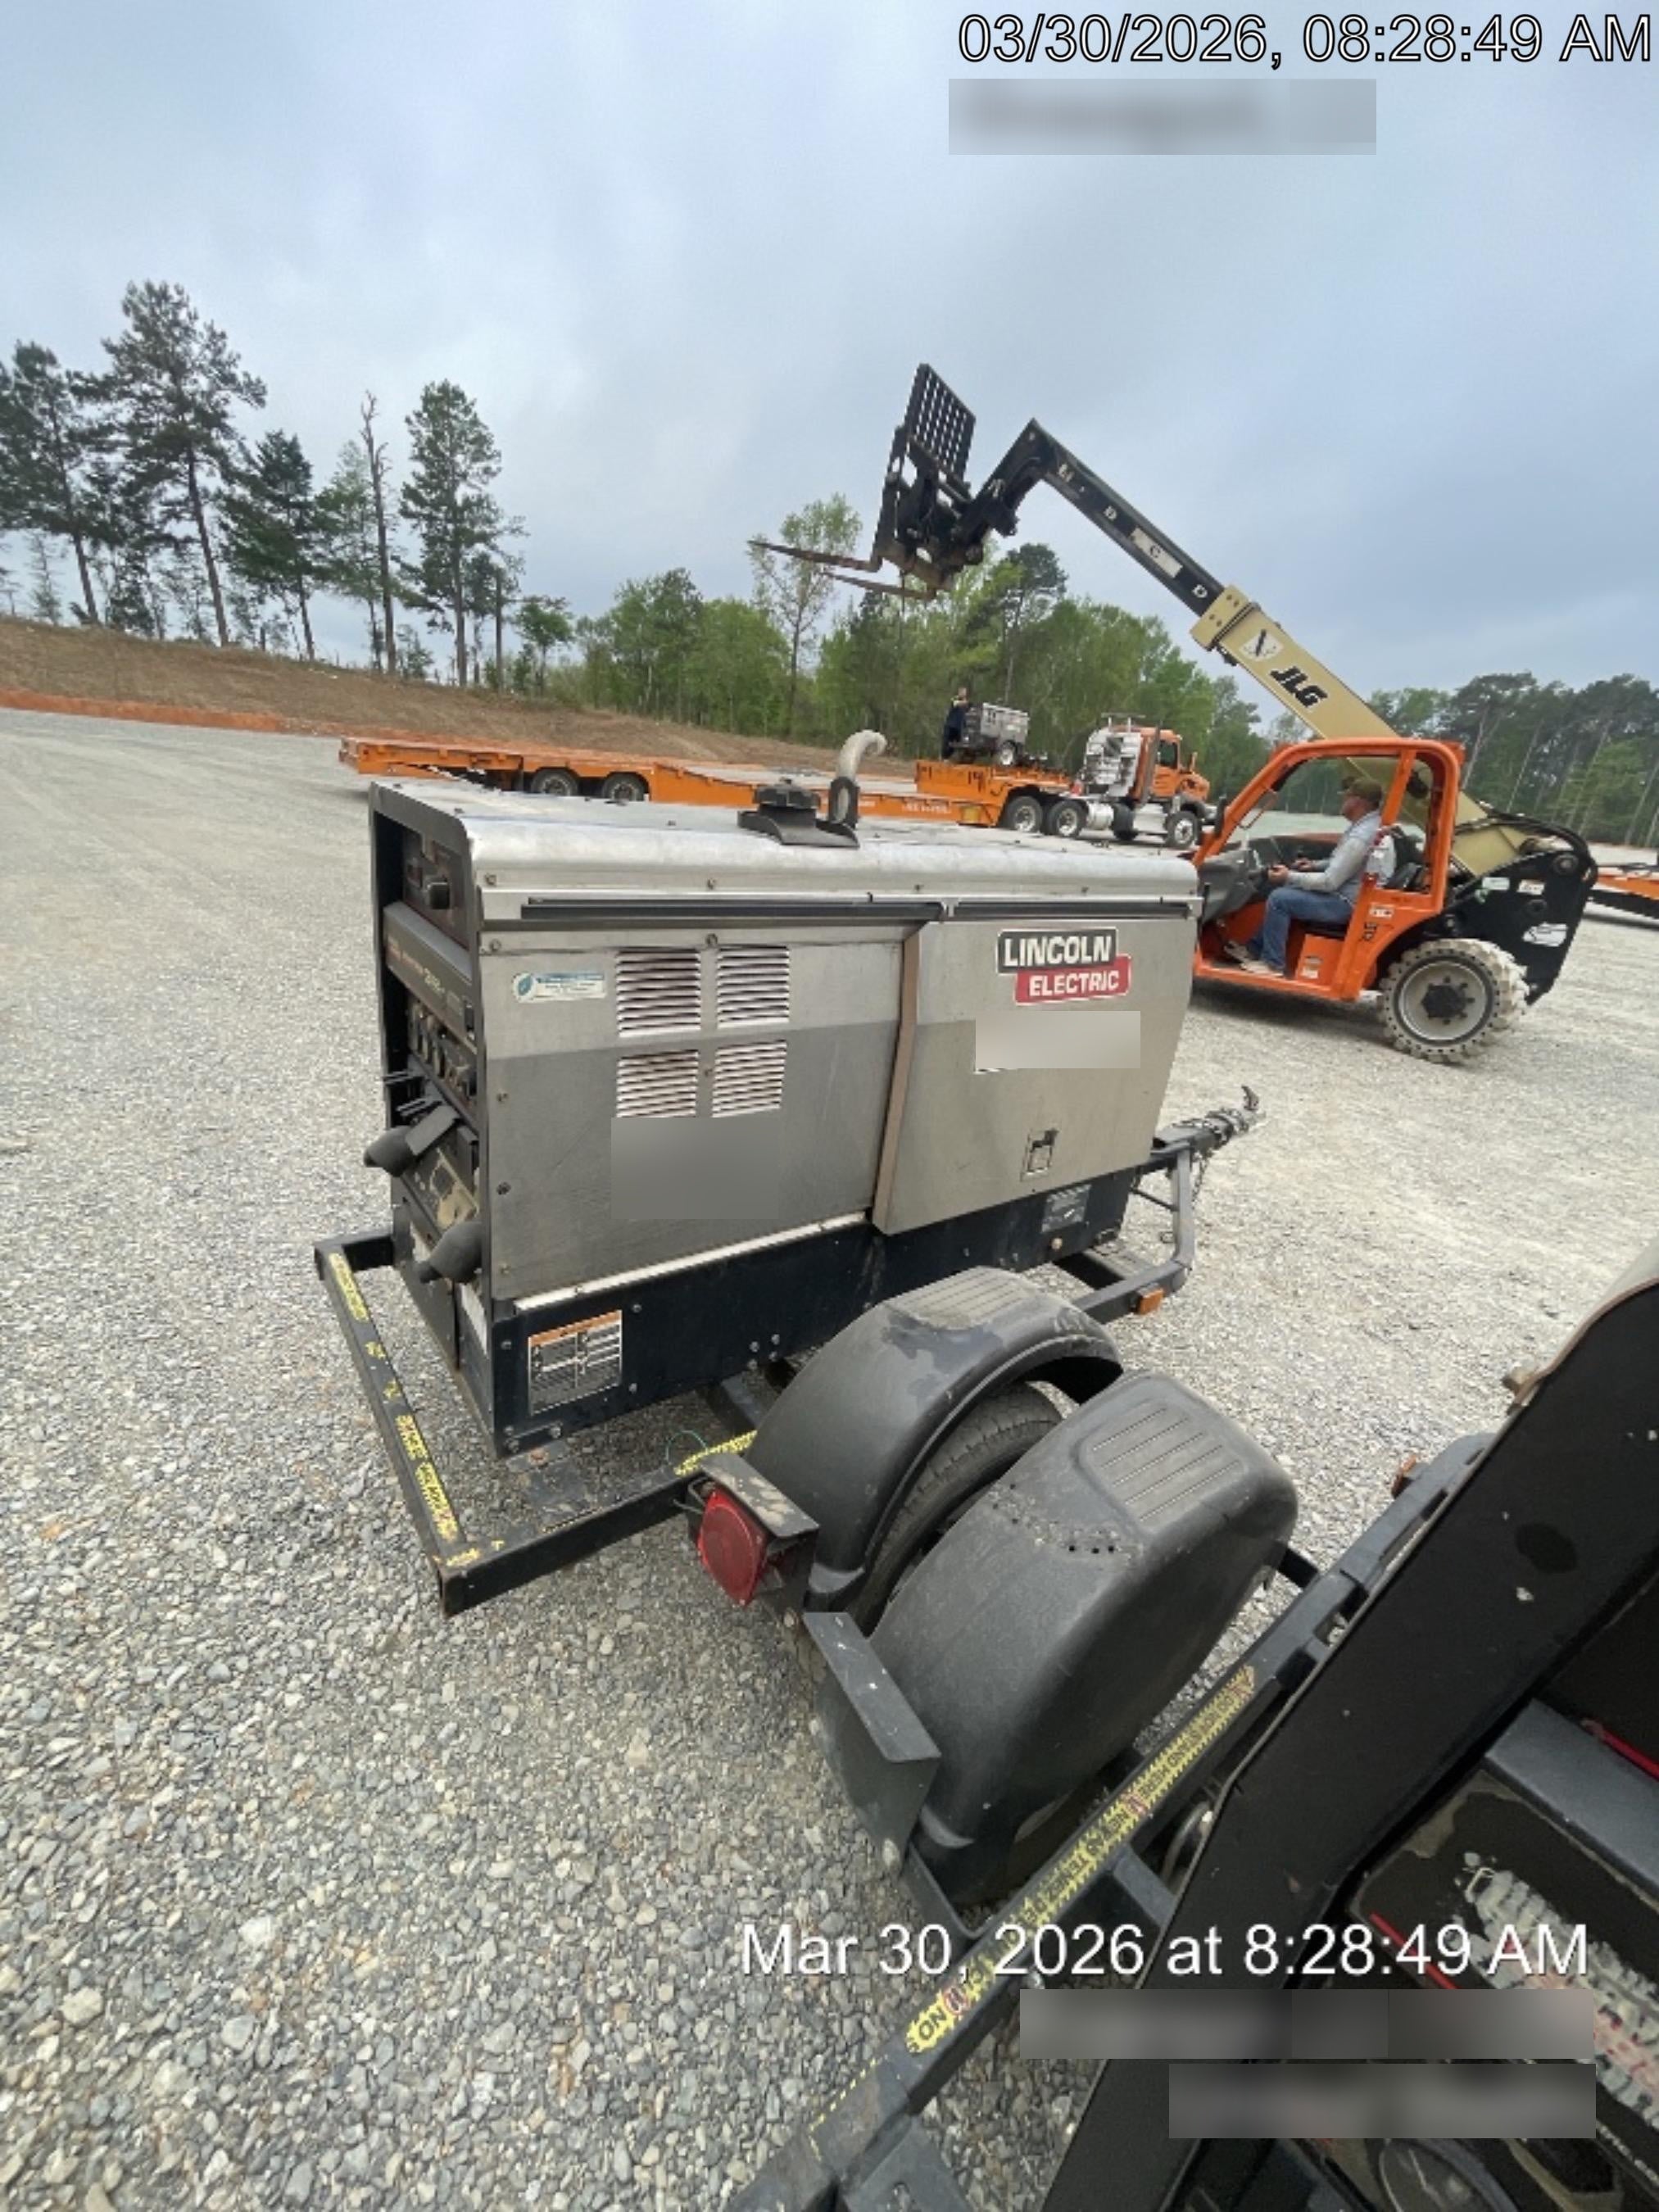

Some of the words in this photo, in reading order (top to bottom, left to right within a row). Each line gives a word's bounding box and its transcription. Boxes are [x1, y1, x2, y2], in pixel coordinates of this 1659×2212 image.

[1269, 665, 1328, 708] JLG
[1004, 936, 1112, 966] LINCOLN
[1029, 971, 1119, 997] ELECTRIC
[1166, 1729, 1203, 1769] STAND
[1137, 1763, 1172, 1799] HERE
[913, 2006, 950, 2043] NO
